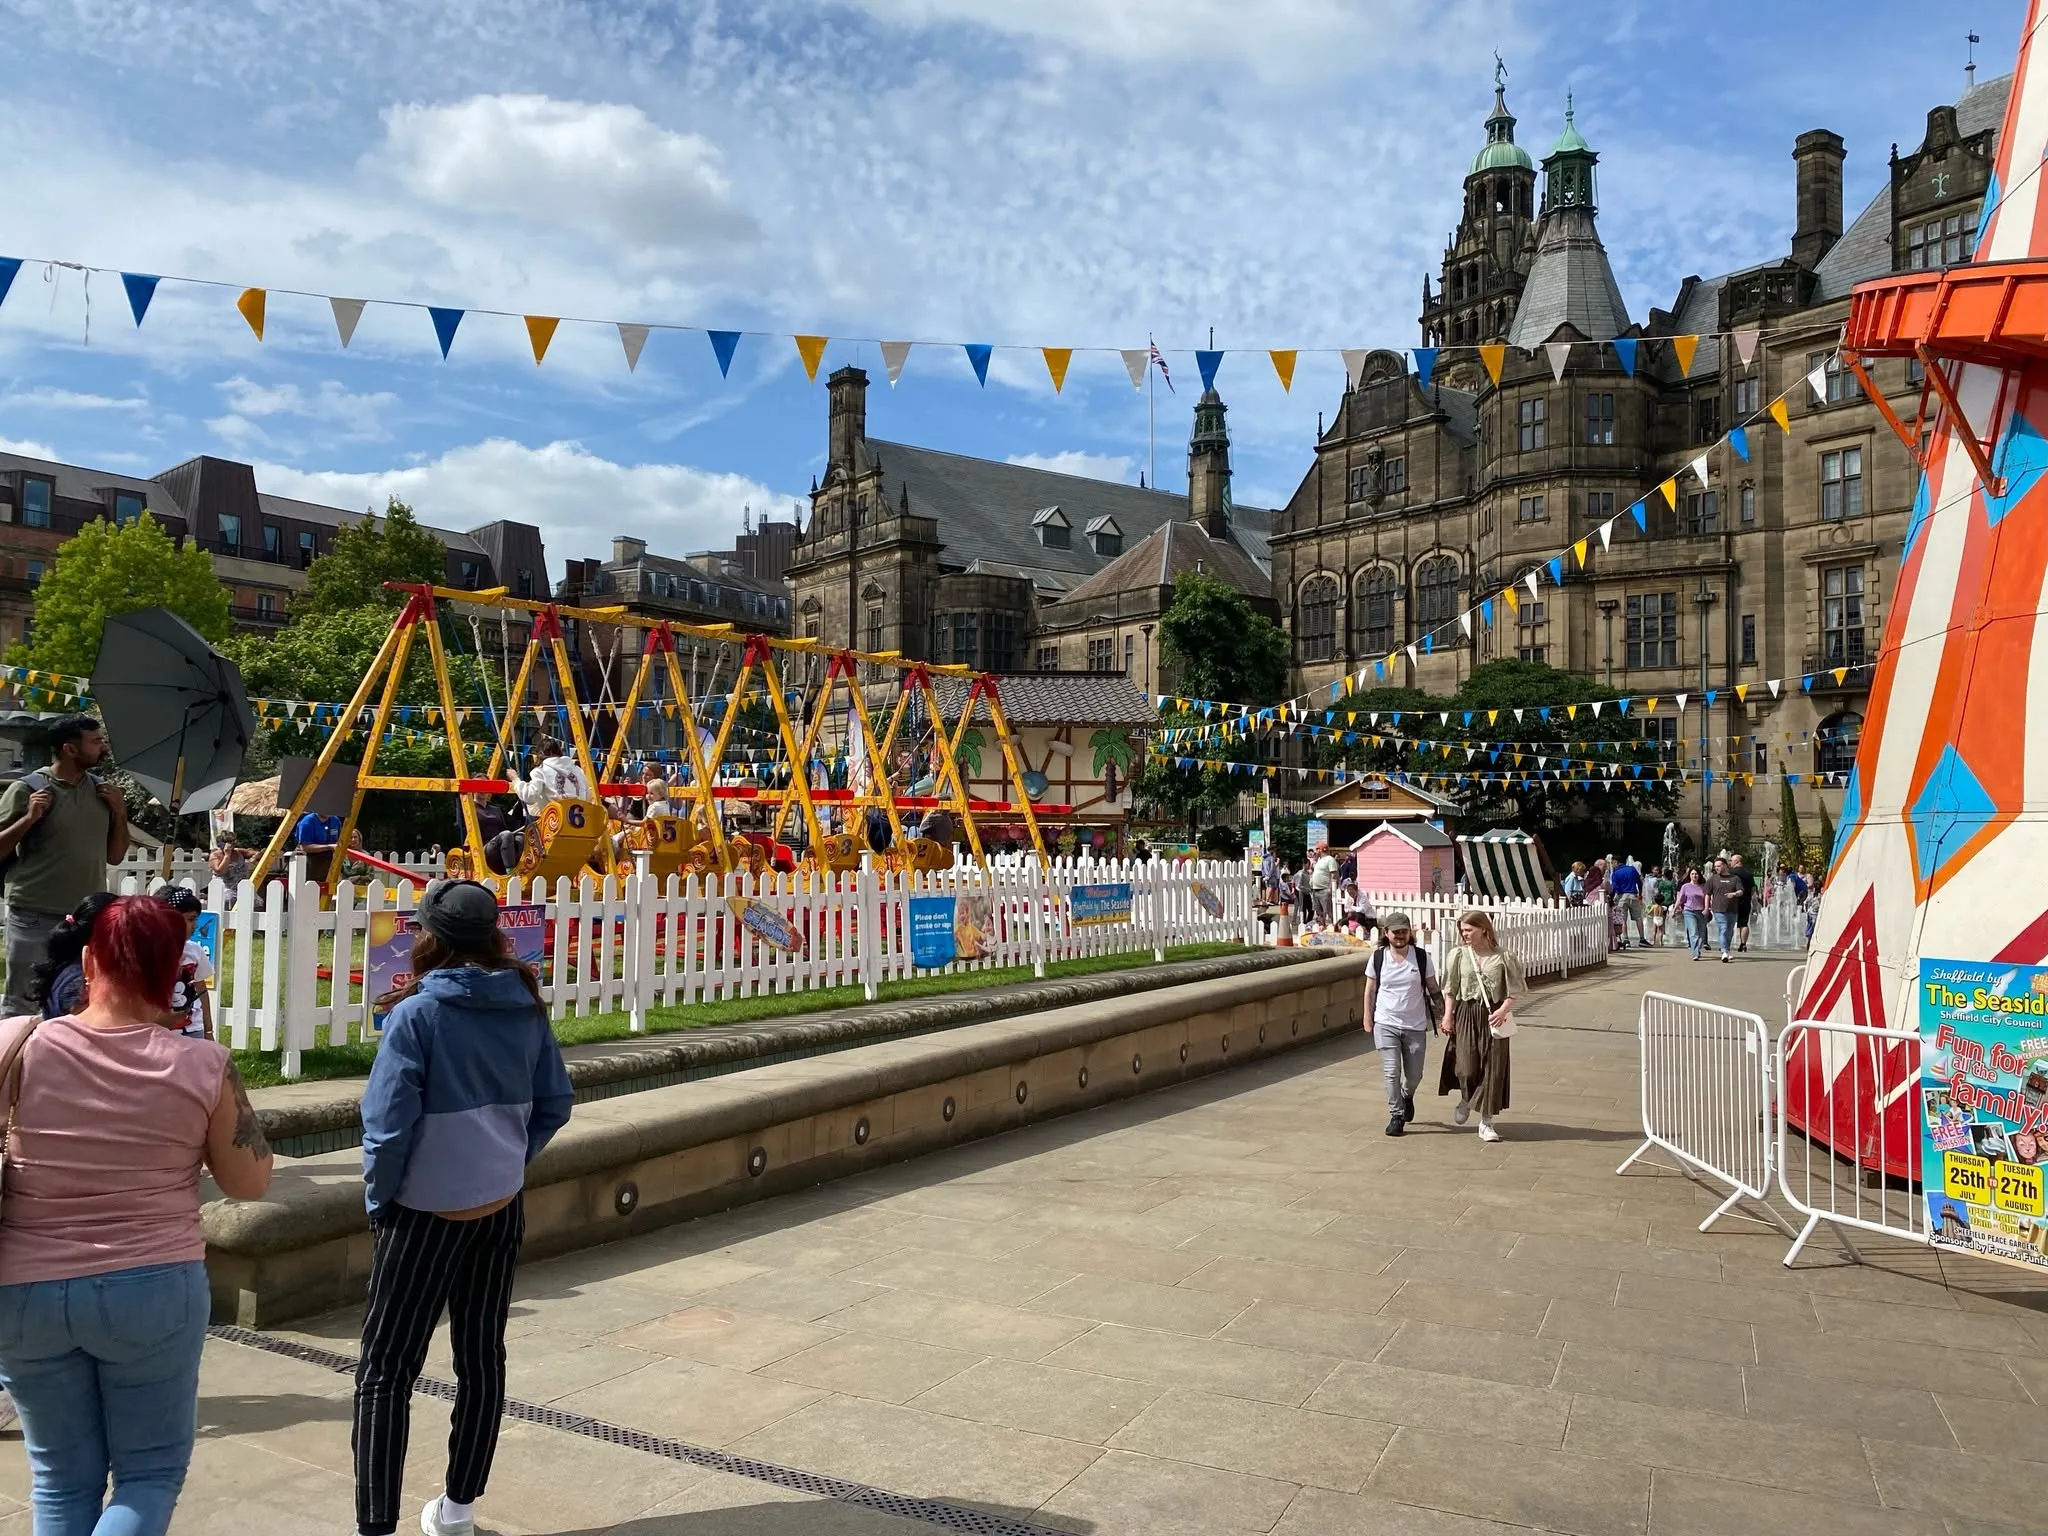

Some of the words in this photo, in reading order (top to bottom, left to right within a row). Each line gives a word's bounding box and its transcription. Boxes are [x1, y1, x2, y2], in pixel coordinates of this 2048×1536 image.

[568, 804, 585, 828] 6
[662, 820, 677, 842] 5
[840, 838, 853, 856] 3
[917, 843, 928, 857] 2
[1100, 899, 1110, 910] The
[1111, 898, 1130, 910] Seaside
[915, 922, 933, 930] smoke
[1931, 968, 1985, 983] Sheffield
[1987, 973, 2003, 987] by
[1925, 983, 1967, 1008] The
[1940, 1010, 1980, 1022] Sheffield
[1982, 1014, 2002, 1027] City
[2004, 1017, 2043, 1029] Council
[1936, 1023, 1984, 1062] Fun
[1990, 1043, 2029, 1077] for
[2020, 1037, 2048, 1052] FREE
[1952, 1057, 1970, 1073] all
[1972, 1061, 1997, 1082] the
[1949, 1072, 2048, 1136] family!
[1930, 1121, 1965, 1142] FREE
[1932, 1136, 1972, 1152] ADMISSION
[1950, 1154, 1985, 1168] THURSDAY
[2002, 1163, 2035, 1177] TUESDAY
[1950, 1166, 1985, 1190] 25th
[1959, 1190, 1977, 1201] JULY
[2001, 1176, 2038, 1200] 27th
[2004, 1199, 2035, 1213] AUGUST
[1968, 1207, 1991, 1219] OPEN
[1993, 1211, 2020, 1225] DAILY
[1929, 1231, 1974, 1249] Sponsored
[1974, 1240, 1987, 1254] by
[1987, 1243, 2022, 1260] Farrars
[2022, 1251, 2048, 1267] Funfa
[1954, 1226, 1986, 1240] SHEFFIELD
[1987, 1234, 2008, 1246] PEACE
[2008, 1238, 2039, 1253] GARDENS
